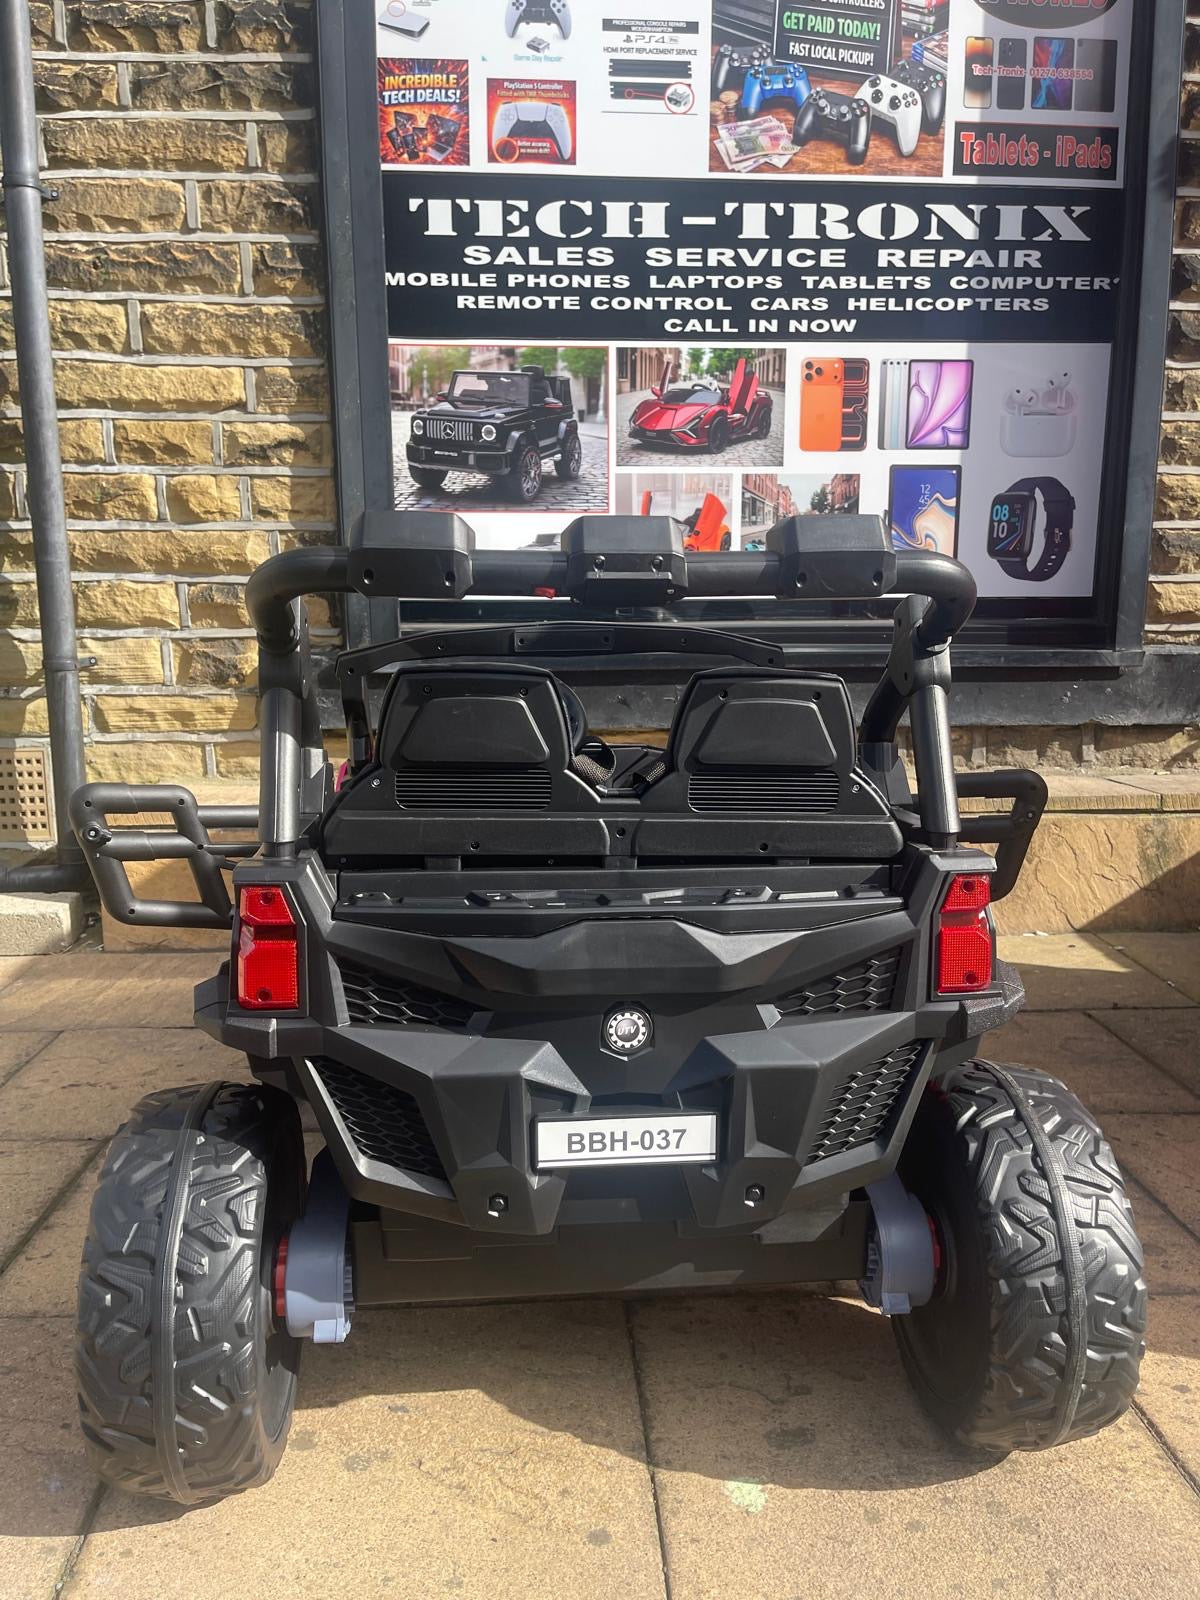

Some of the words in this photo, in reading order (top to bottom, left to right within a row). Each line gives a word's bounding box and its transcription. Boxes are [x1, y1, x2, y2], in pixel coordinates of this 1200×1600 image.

[783, 11, 806, 30] GET
[807, 15, 835, 34] PAID
[837, 18, 881, 41] TODAY!
[635, 35, 665, 43] PS4
[789, 42, 810, 57] FAST
[811, 44, 837, 61] LOCAL
[838, 49, 875, 67] PICKUP!
[1029, 67, 1056, 79] 01274
[384, 74, 458, 91] INCREDIBLE
[382, 90, 415, 105] TECH
[416, 88, 461, 103] DEALS!
[960, 132, 1040, 166] Tablets
[1055, 135, 1112, 169] iPads
[408, 198, 1092, 241] TECH-TRONIX
[463, 245, 615, 267] SALES
[645, 247, 847, 268] SERVICE
[877, 249, 1043, 269] REPAIR
[384, 271, 498, 288] MOBILE
[507, 273, 631, 289] PHONES
[649, 274, 783, 290] LAPTOPS
[801, 275, 931, 290] TABLETS
[949, 275, 1121, 291] COMPUTER
[456, 295, 581, 310] REMOTE
[590, 296, 733, 311] CONTROL
[750, 297, 830, 312] CARS
[847, 297, 1050, 312] HELICOPTERS
[664, 318, 739, 333] CALL
[747, 318, 779, 333] IN
[788, 318, 857, 333] NOW
[919, 484, 931, 494] 12
[918, 495, 930, 505] 45
[992, 504, 1009, 521] 08
[993, 521, 1008, 539] 10
[617, 1026, 637, 1036] UTV
[567, 1129, 687, 1153] BBH-037
